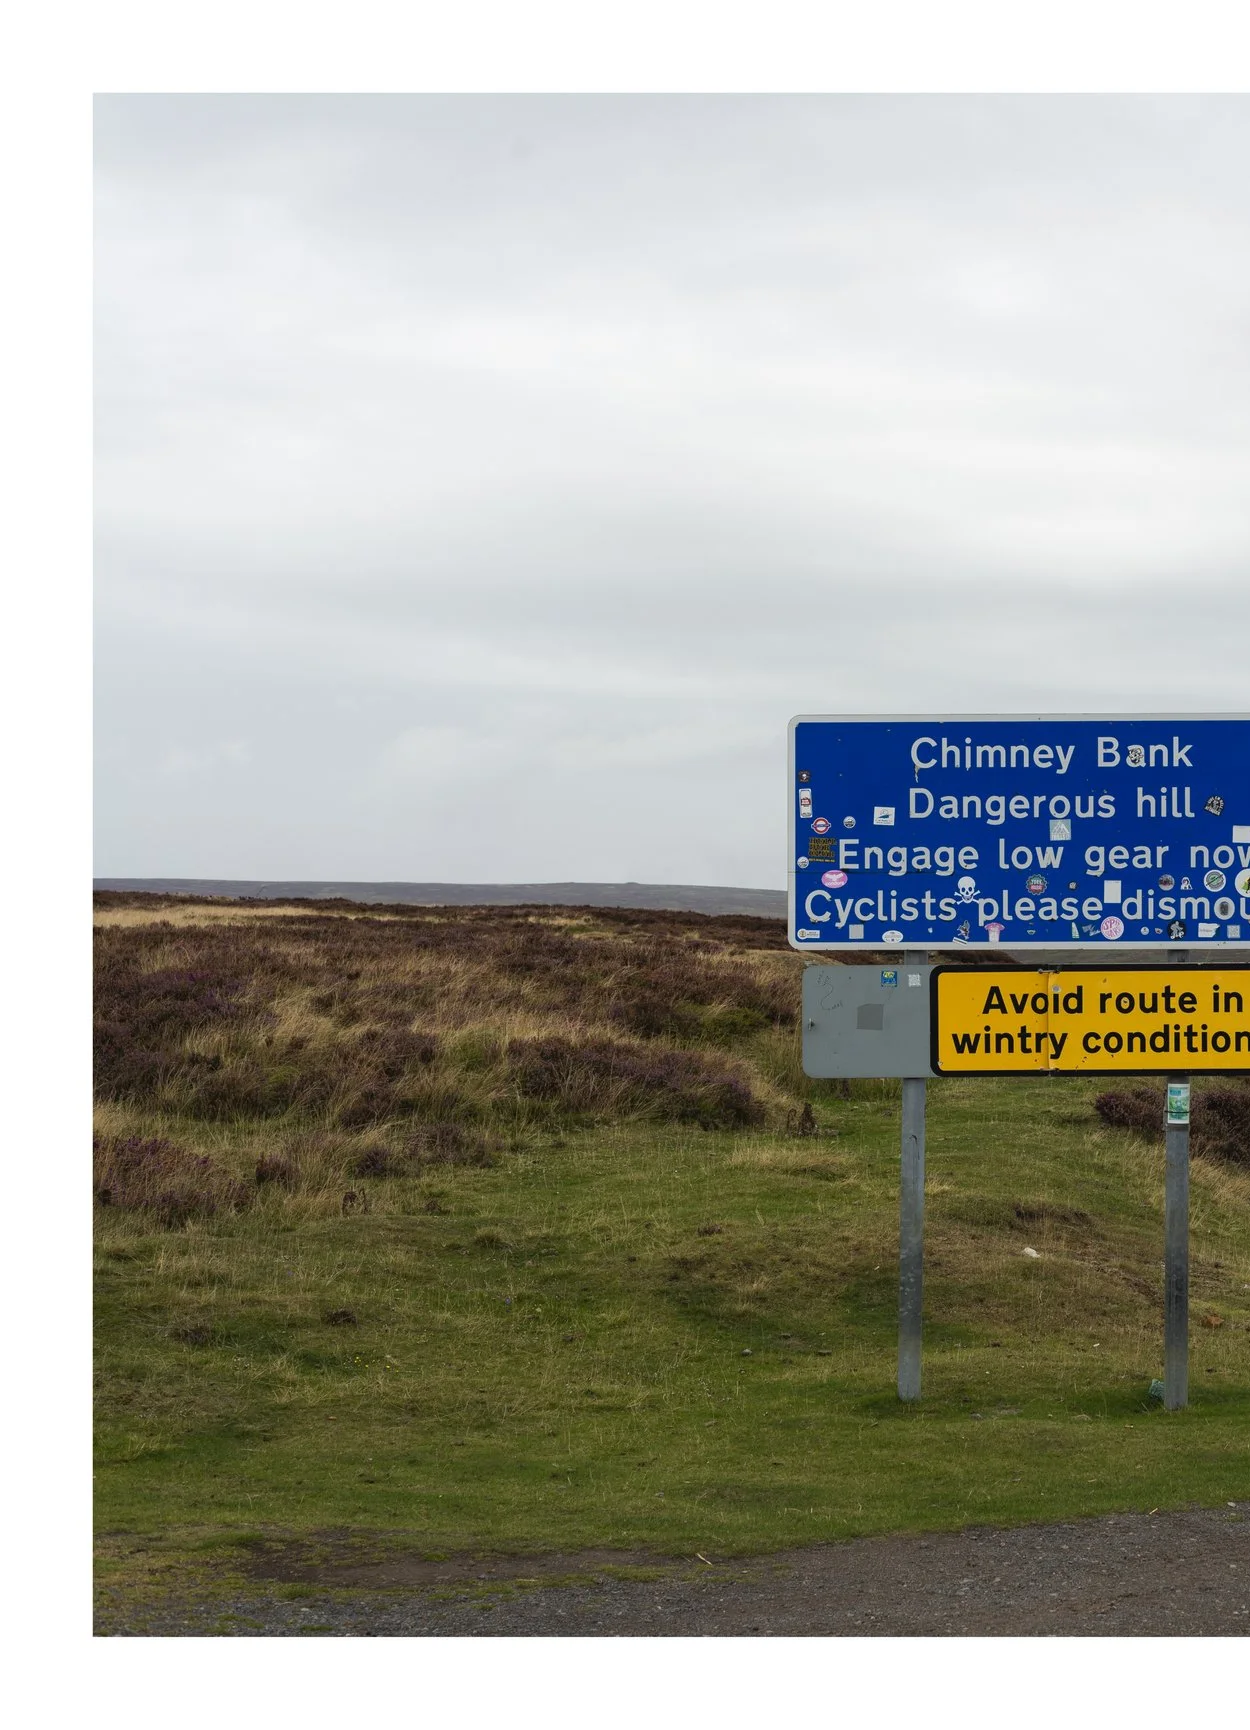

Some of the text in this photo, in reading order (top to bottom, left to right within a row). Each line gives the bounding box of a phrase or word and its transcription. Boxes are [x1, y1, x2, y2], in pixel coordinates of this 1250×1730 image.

[910, 736, 1193, 775] Chimney Bank
[909, 787, 1116, 826] Dangerous
[1137, 786, 1195, 818] hill
[839, 838, 979, 877] Engage
[999, 838, 1064, 869] low
[1084, 845, 1169, 877] gear
[804, 889, 957, 928] Cyclists
[978, 889, 1103, 927] please
[982, 984, 1243, 1015] Avoid route in
[951, 1025, 1068, 1060] wintry
